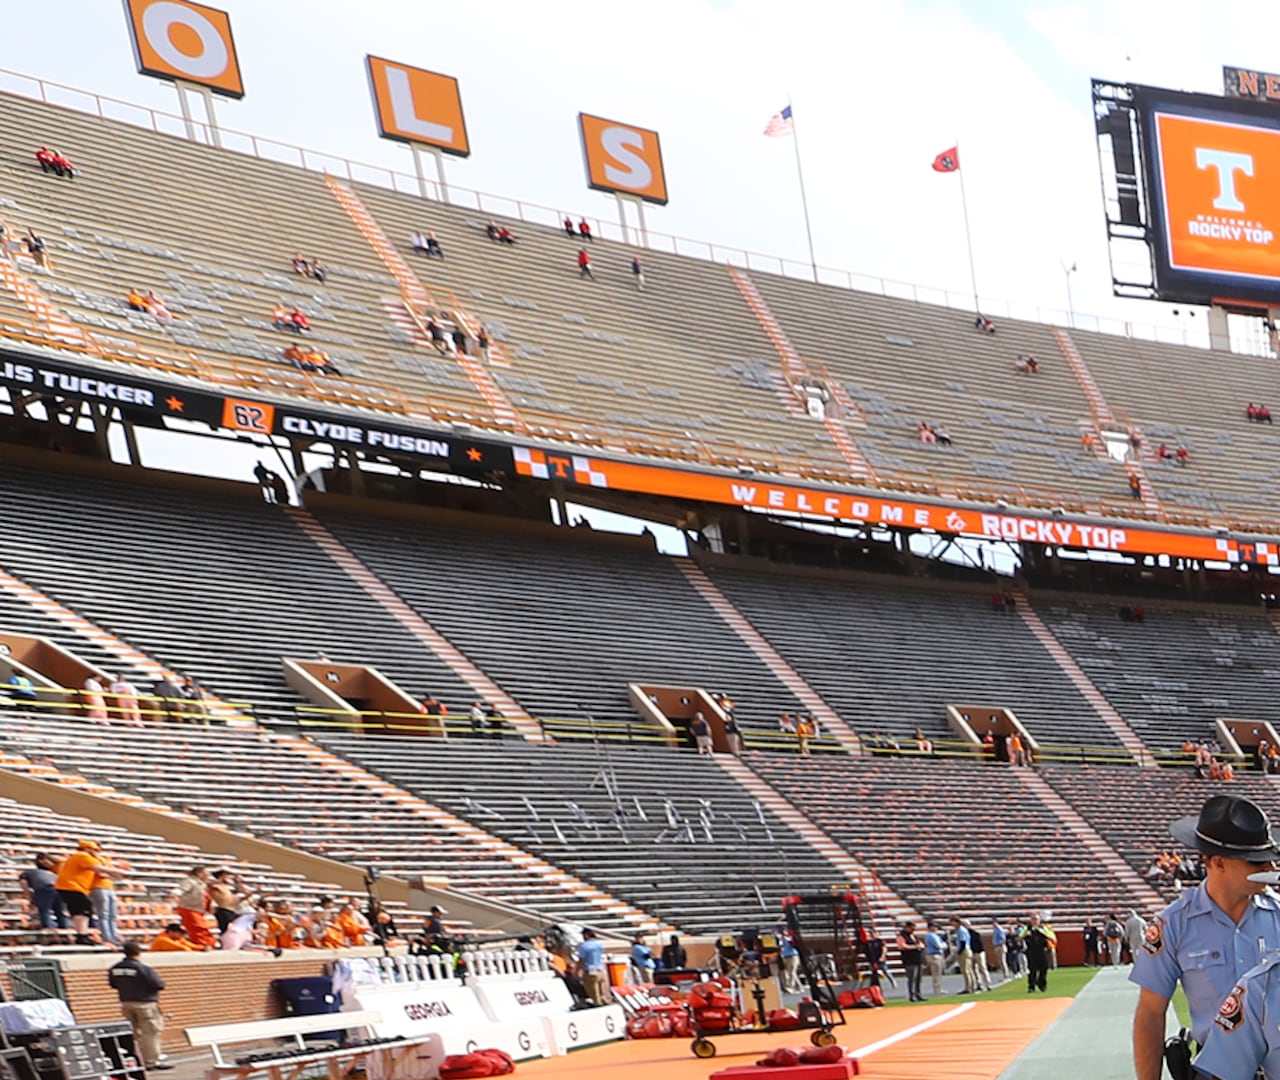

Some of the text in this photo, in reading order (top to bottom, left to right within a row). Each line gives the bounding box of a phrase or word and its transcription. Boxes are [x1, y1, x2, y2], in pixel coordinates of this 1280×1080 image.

[1195, 147, 1254, 212] T
[1188, 221, 1274, 244] ROCKY TOP
[38, 369, 155, 407] TUCKER
[233, 405, 265, 429] 62
[282, 415, 450, 458] CLYDE FUSON
[730, 484, 1127, 549] WELCOME to ROCKY TOP
[404, 1000, 453, 1021] GEORGIA
[514, 990, 551, 1005] GEORGIA
